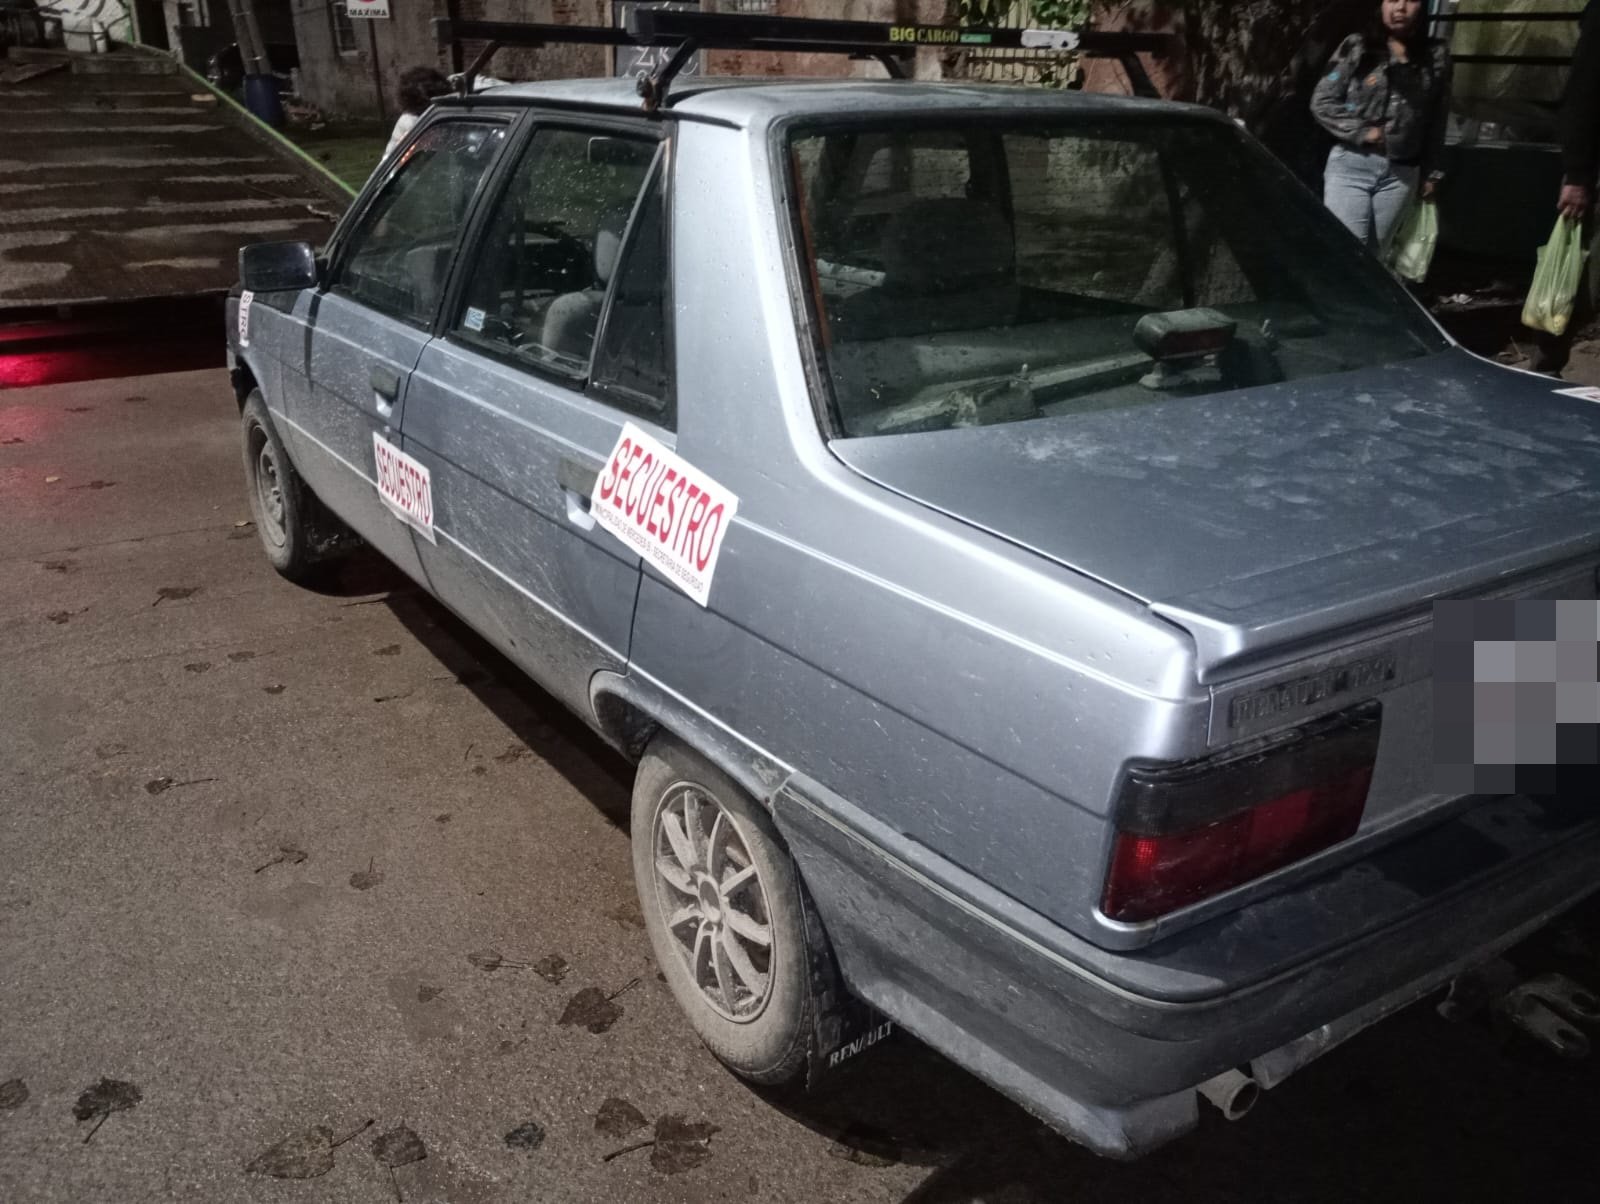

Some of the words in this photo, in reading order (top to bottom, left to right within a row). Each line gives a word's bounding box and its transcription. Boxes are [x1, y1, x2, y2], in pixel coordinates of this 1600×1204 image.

[889, 26, 916, 42] BIG
[917, 28, 960, 42] CARGO
[376, 442, 432, 526] SECUESTRO
[600, 437, 725, 573] SECUESTRO
